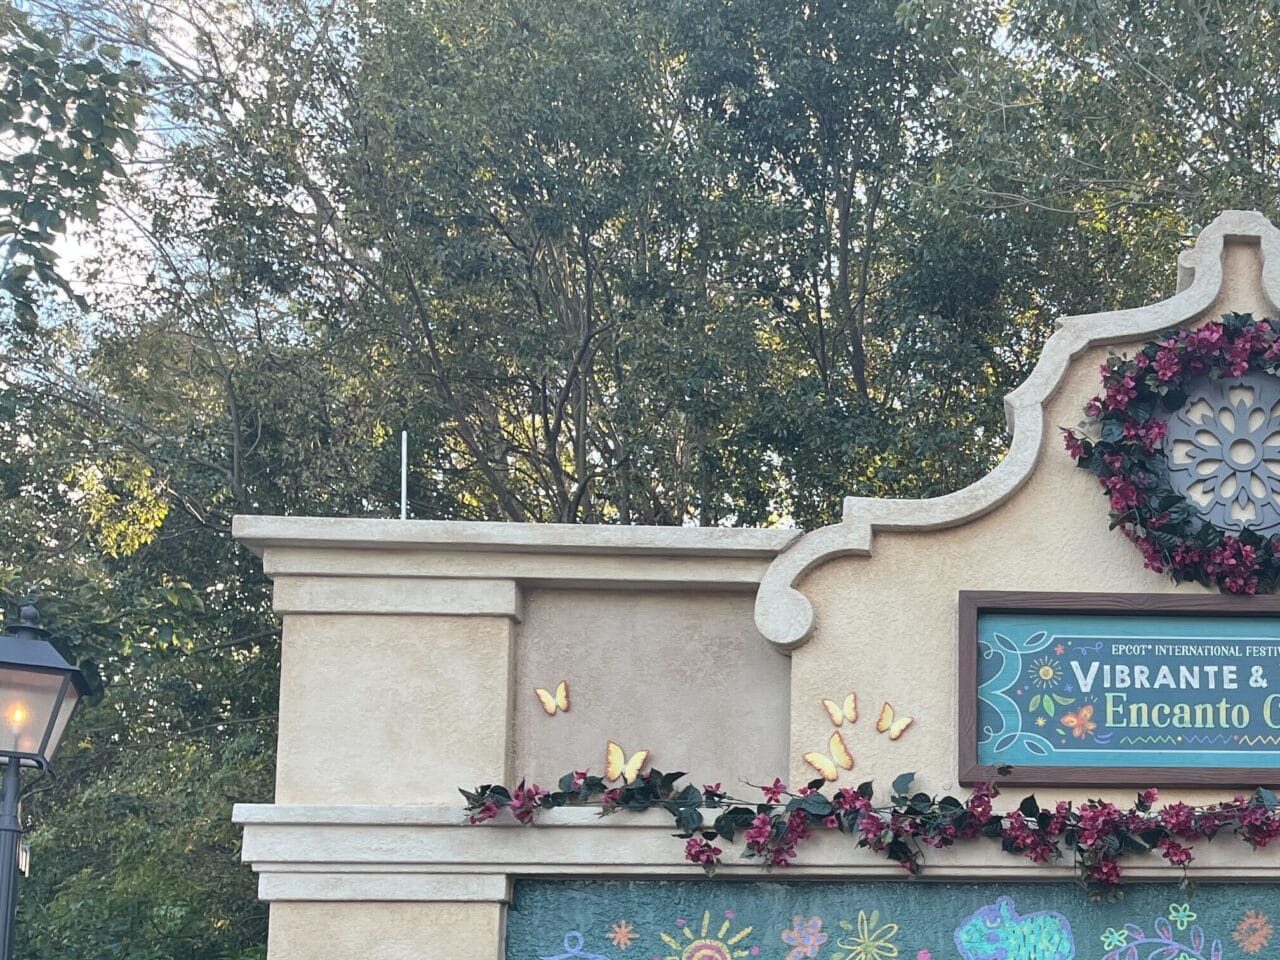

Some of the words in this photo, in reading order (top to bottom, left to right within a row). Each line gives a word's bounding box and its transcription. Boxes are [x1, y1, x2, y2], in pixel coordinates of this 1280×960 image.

[1155, 645, 1243, 657] INTERNATIONAL
[1069, 660, 1239, 693] VIBRANTE
[1249, 665, 1268, 689] &
[1104, 692, 1250, 729] Encanto
